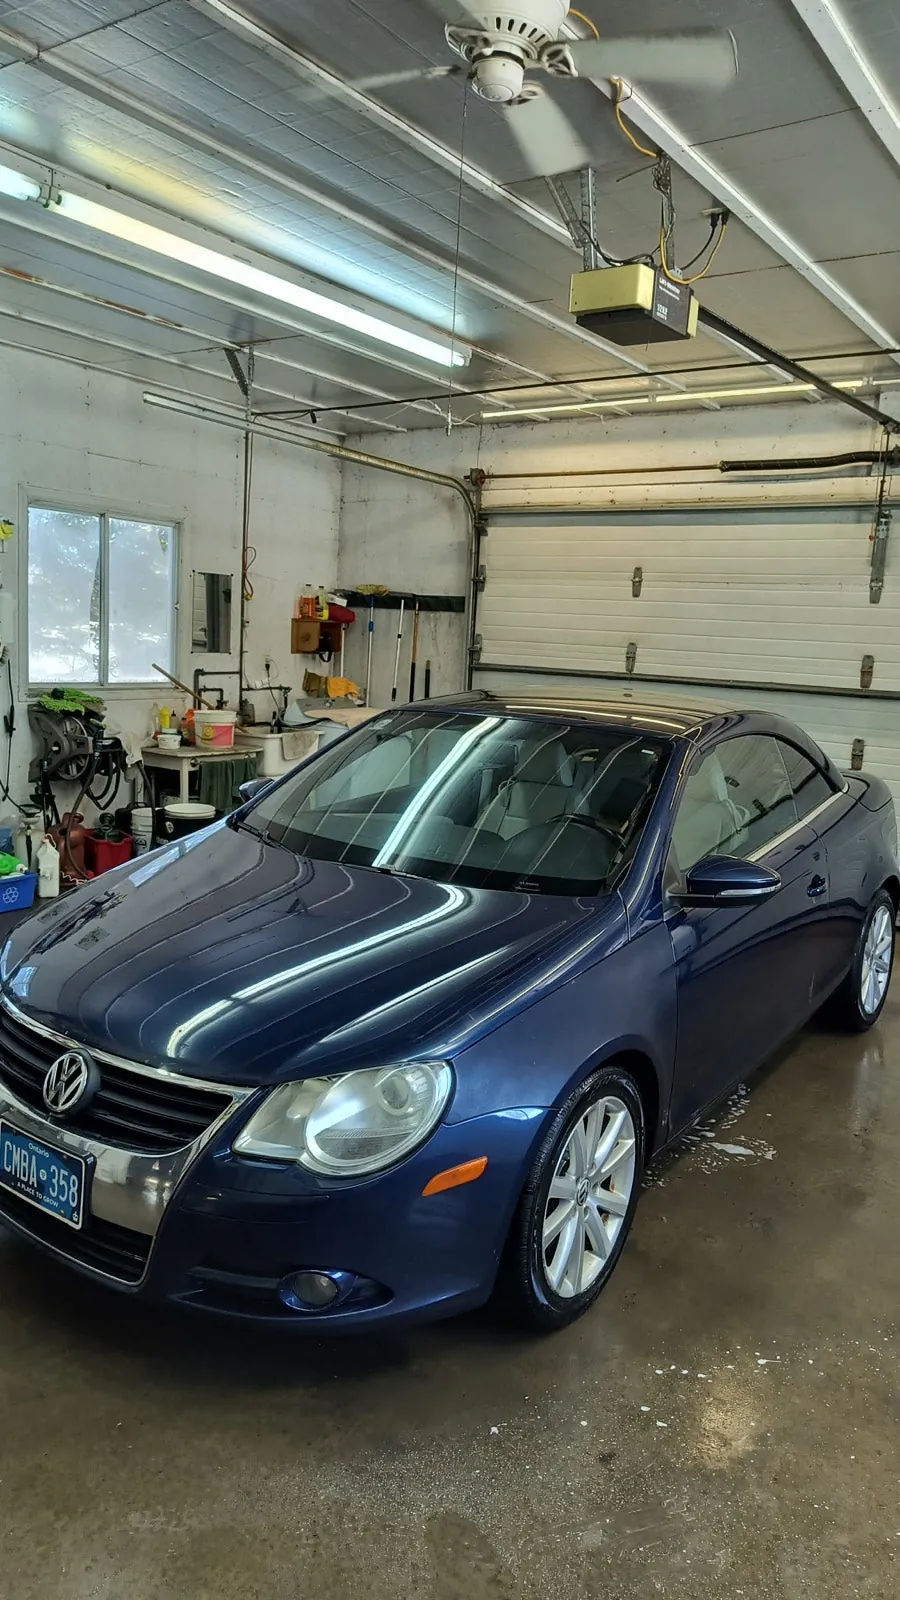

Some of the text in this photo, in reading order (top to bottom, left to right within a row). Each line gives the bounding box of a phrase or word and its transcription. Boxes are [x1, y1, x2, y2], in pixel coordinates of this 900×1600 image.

[28, 1142, 50, 1158] Ontario
[4, 1140, 79, 1208] CMBA 358
[21, 1184, 35, 1196] PLACE
[36, 1191, 43, 1200] TO
[43, 1195, 59, 1208] GROW
